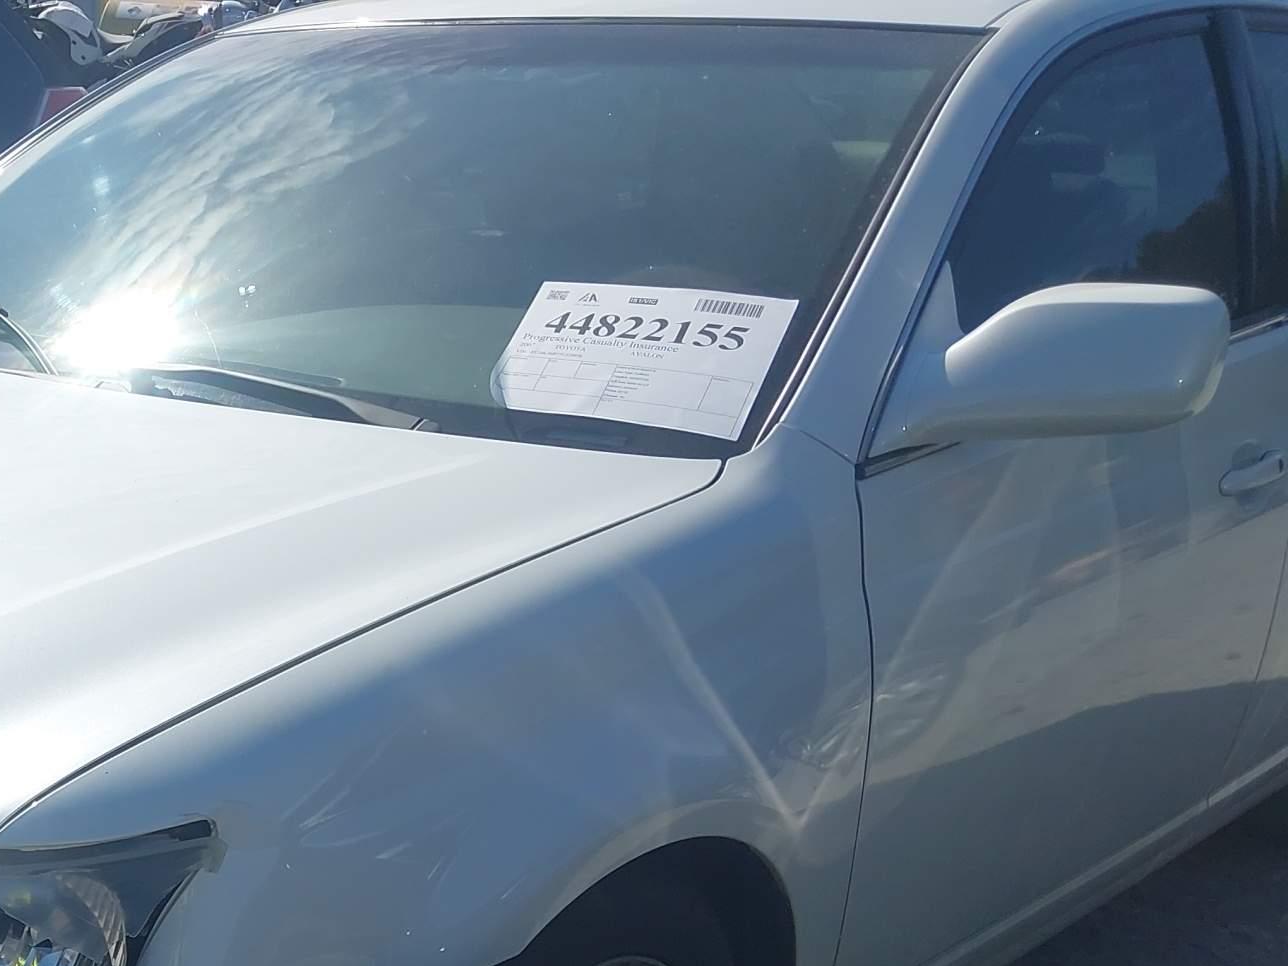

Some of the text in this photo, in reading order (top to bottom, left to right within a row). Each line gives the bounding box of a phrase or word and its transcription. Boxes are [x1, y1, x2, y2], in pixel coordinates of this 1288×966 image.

[523, 332, 679, 353] Progressive Casualty Insurance
[545, 311, 751, 351] 44822155
